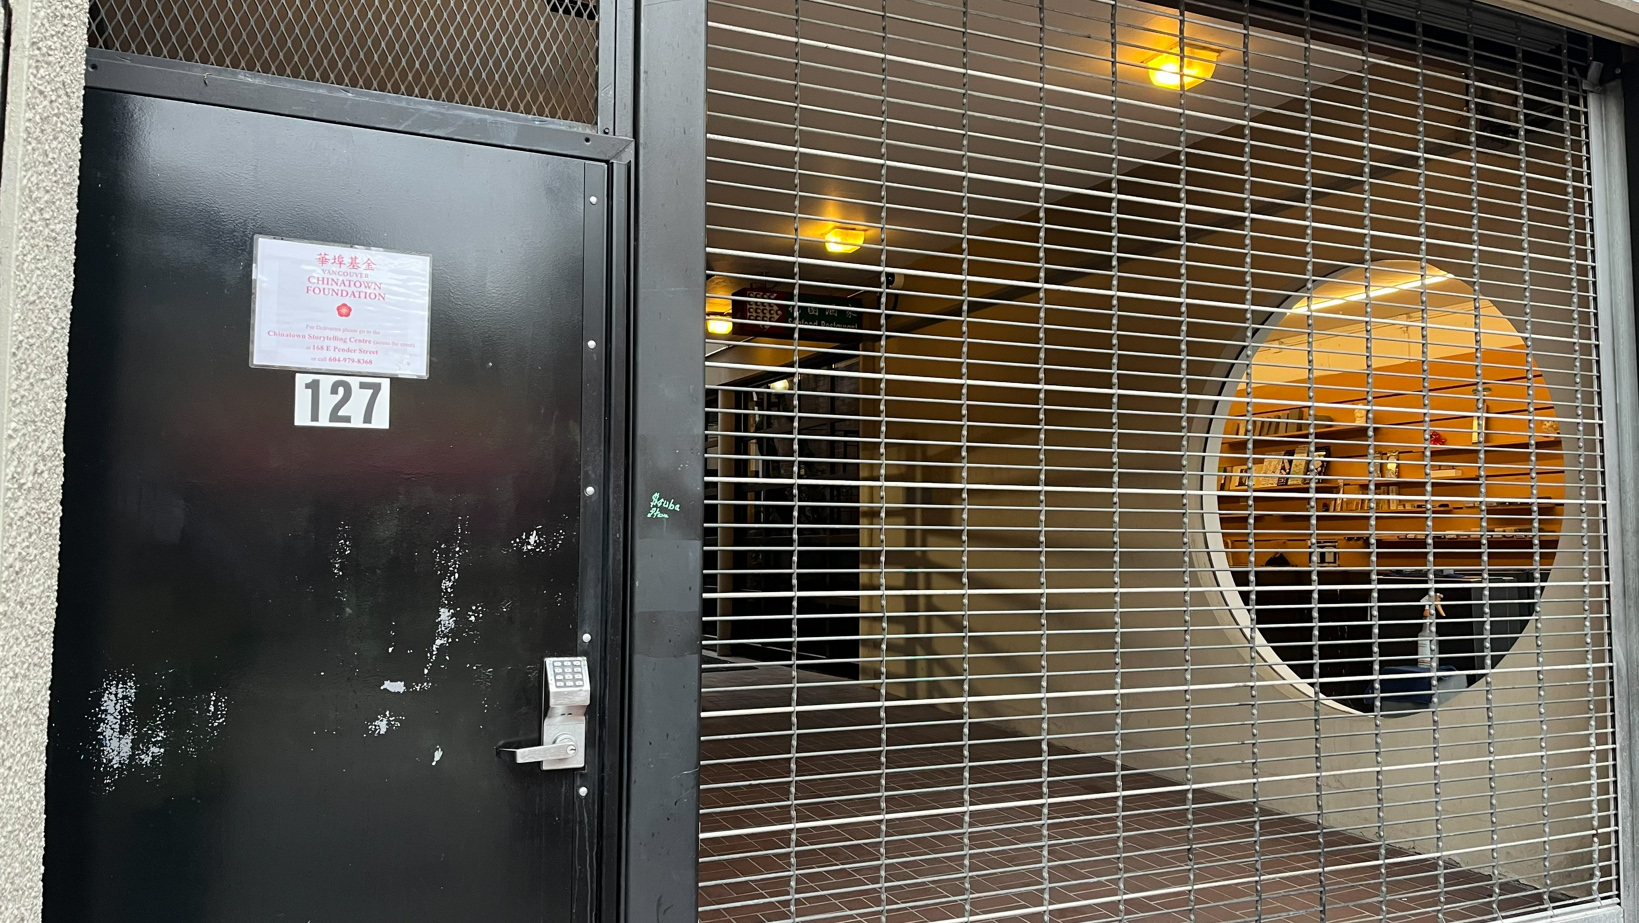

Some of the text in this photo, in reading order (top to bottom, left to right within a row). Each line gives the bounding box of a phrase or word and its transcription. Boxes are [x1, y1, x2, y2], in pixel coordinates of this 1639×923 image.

[316, 252, 377, 271] 華埠基金
[321, 269, 370, 279] VANCOUVER
[307, 275, 383, 291] CHINATOWN
[305, 285, 386, 301] FOUNDATION
[267, 330, 306, 339] Chinatown
[307, 334, 347, 344] Storytelling
[349, 336, 372, 345] Centre
[333, 346, 357, 354] Pender
[358, 347, 379, 356] Street
[328, 356, 373, 366] 604-979-8368
[304, 378, 382, 425] 127
